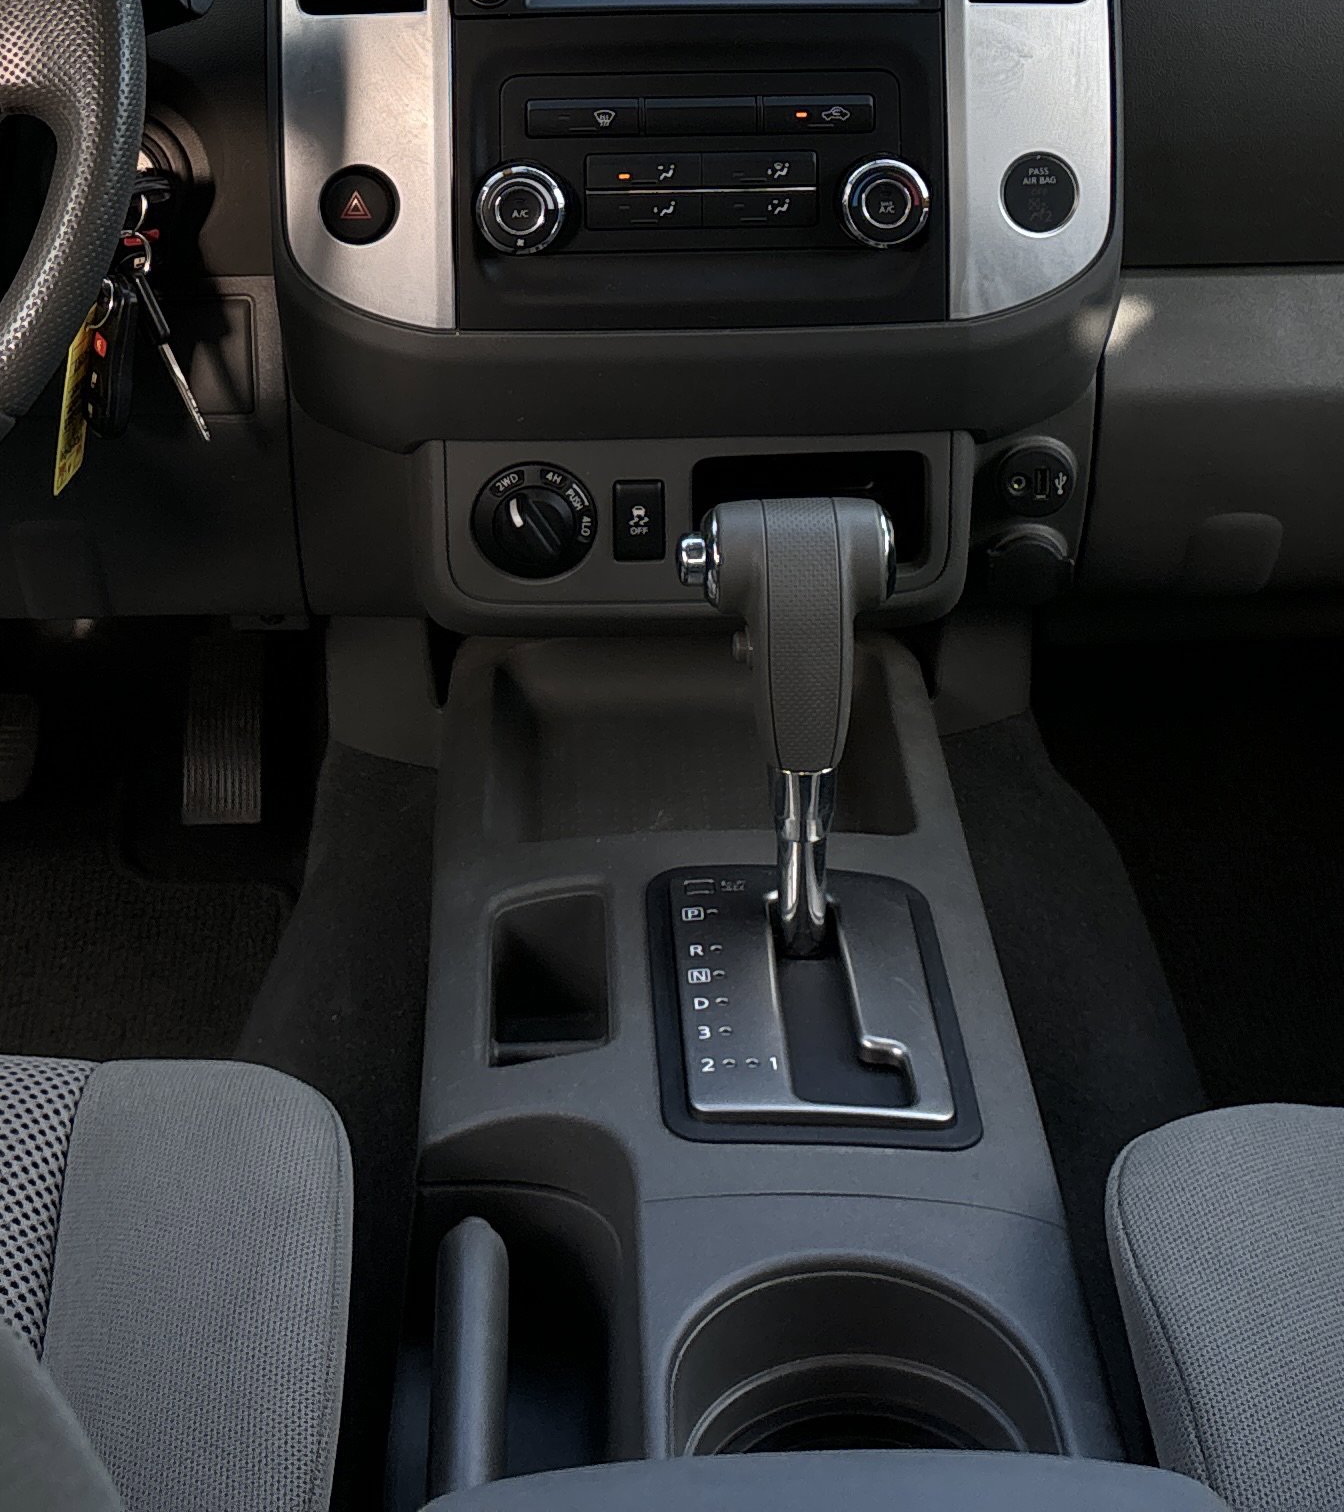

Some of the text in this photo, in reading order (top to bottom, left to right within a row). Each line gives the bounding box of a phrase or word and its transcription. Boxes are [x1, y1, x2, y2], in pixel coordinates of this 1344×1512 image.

[1028, 167, 1050, 176] PASS
[1022, 175, 1057, 185] AIR BAG
[511, 209, 529, 219] A/C
[878, 205, 895, 214] A/C
[495, 473, 519, 492] 2WD
[545, 471, 562, 485] 4H
[565, 489, 584, 511] PUSH
[580, 515, 592, 536] 4LO
[630, 526, 649, 536] OFF
[687, 909, 699, 920] P
[689, 944, 704, 957] R
[692, 970, 707, 982] N
[693, 997, 709, 1010] D
[697, 1026, 712, 1040] 3
[701, 1056, 779, 1072] 2 1
